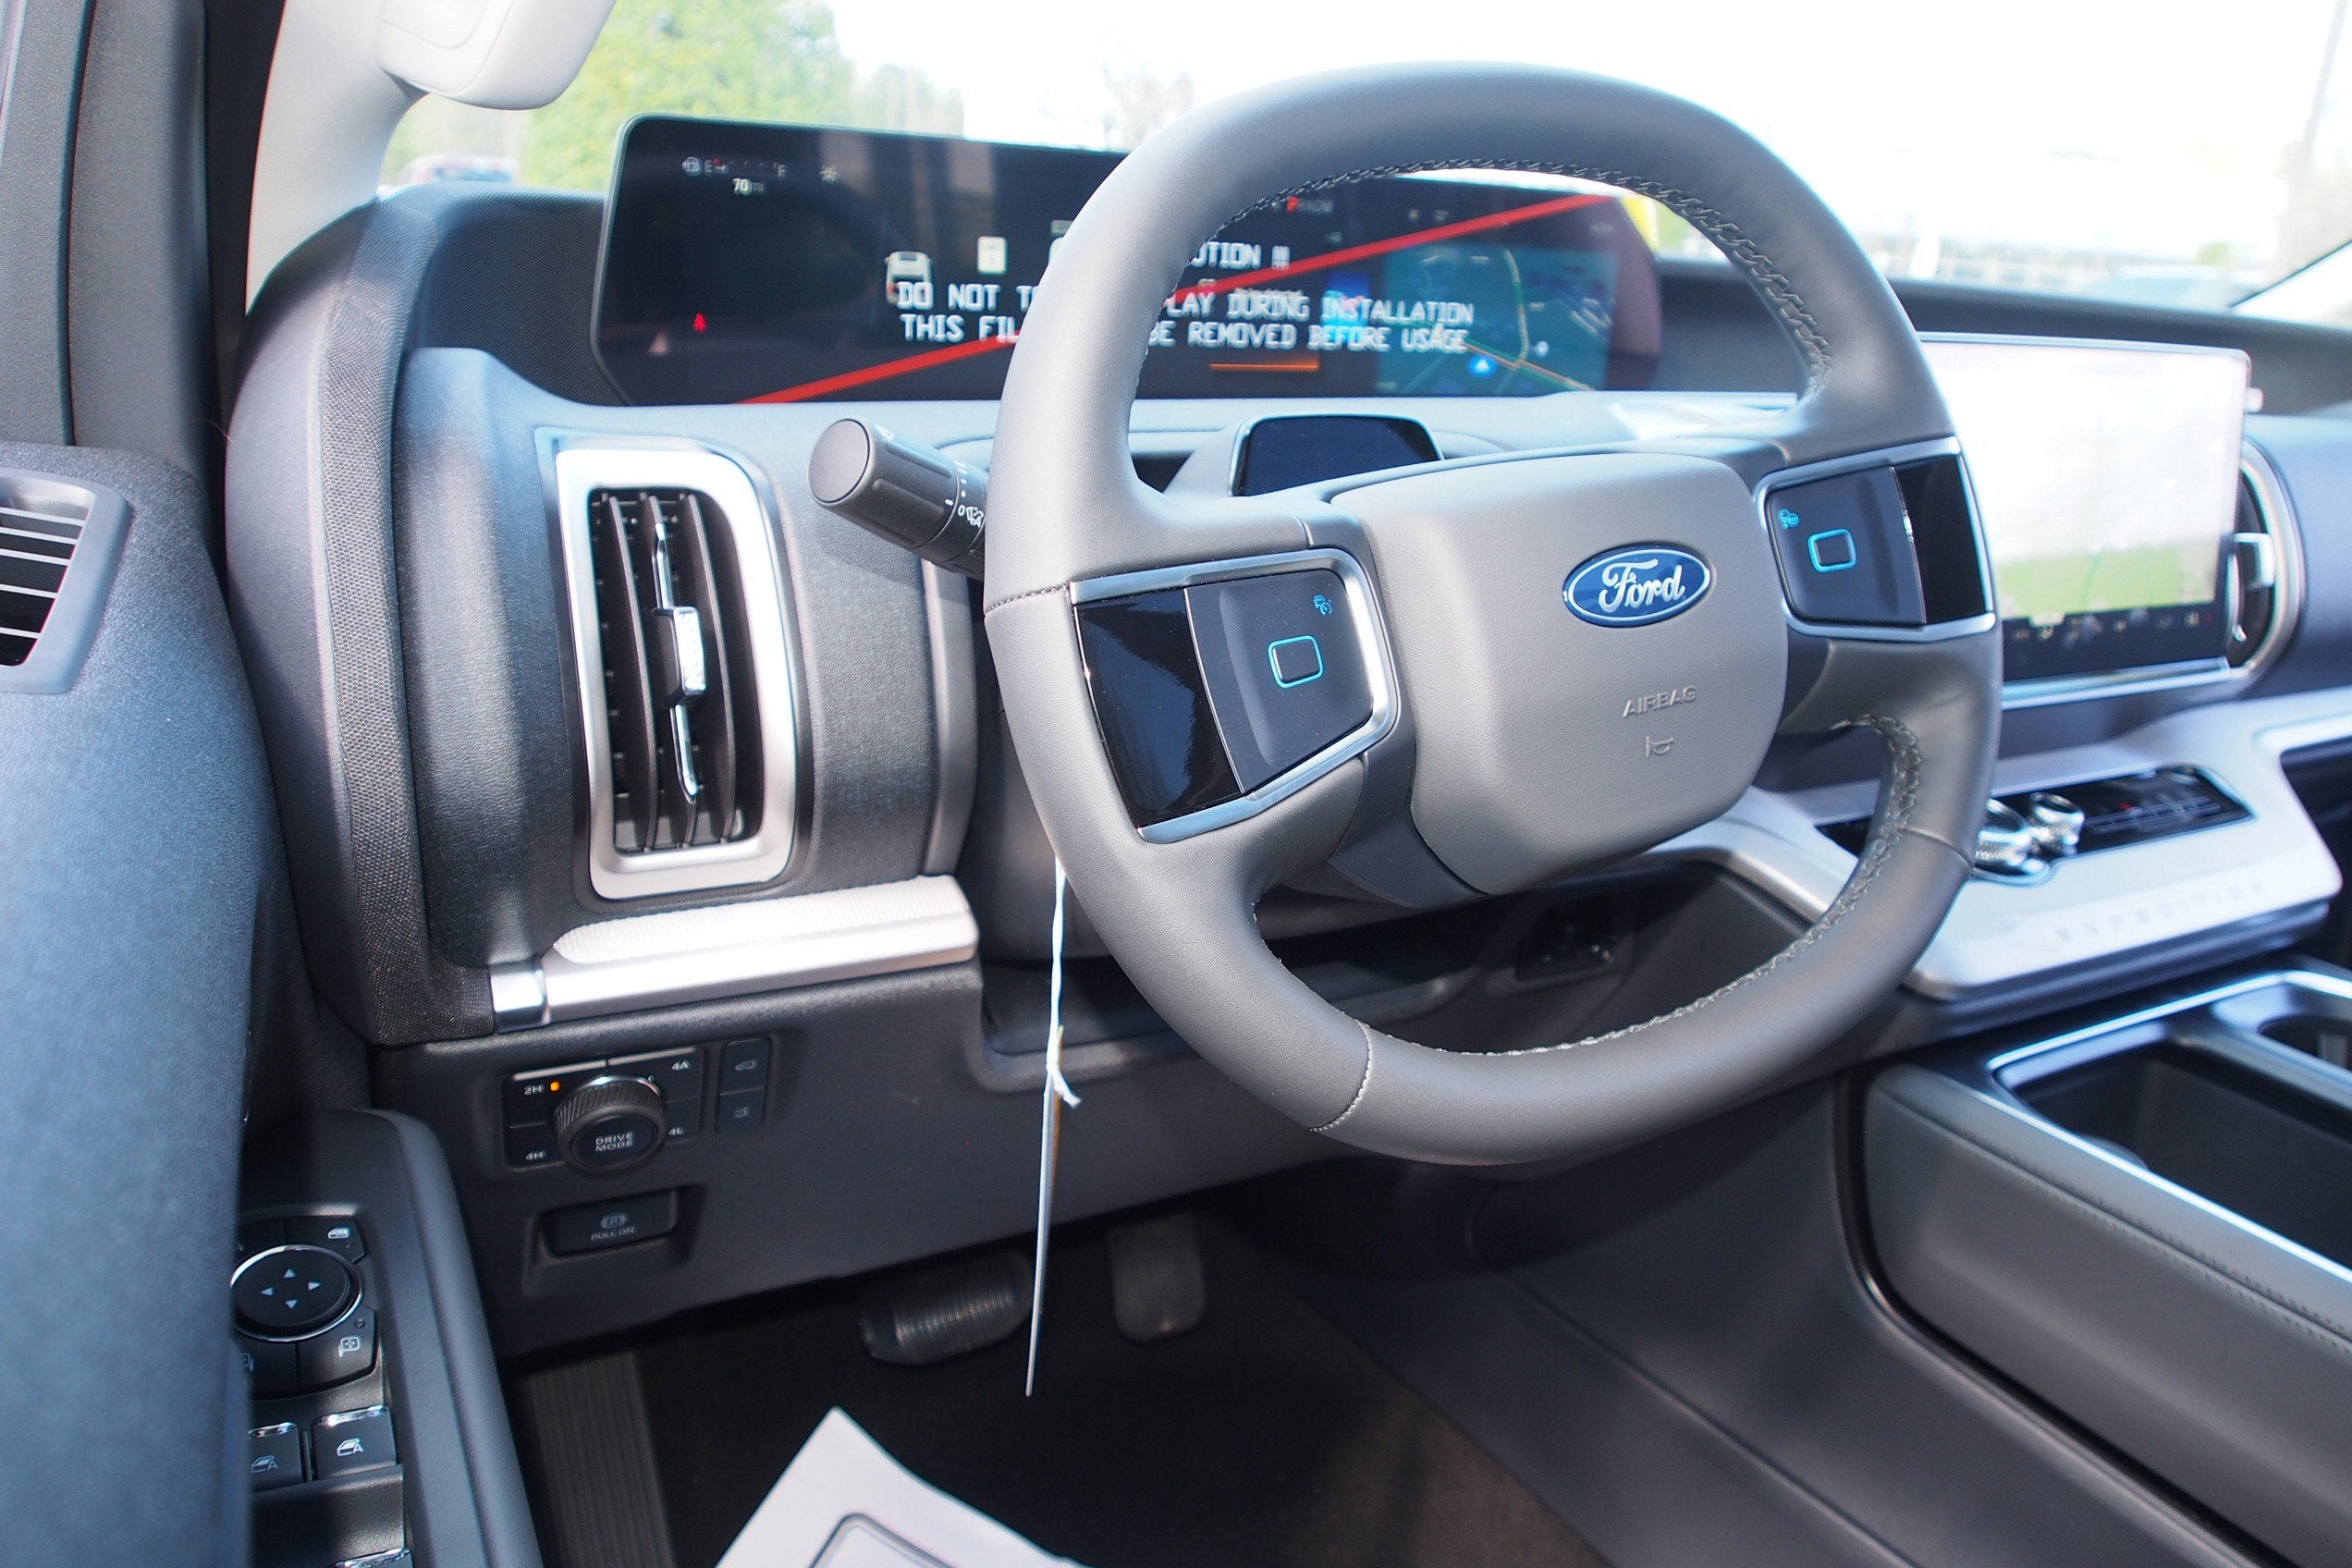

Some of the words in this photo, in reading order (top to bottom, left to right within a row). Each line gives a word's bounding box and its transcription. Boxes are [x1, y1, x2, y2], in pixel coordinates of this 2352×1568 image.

[732, 178, 753, 194] 70
[1190, 241, 1262, 269] UTION
[896, 281, 934, 311] DO
[948, 283, 1001, 312] NOT
[1226, 293, 1310, 322] DURING
[1321, 296, 1475, 325] INSTALLATION
[900, 313, 965, 343] THIS
[978, 315, 1021, 344] FIL
[1187, 321, 1297, 350] REMOVED
[1307, 325, 1390, 352] BEFORE
[1400, 324, 1469, 354] USAGE
[1599, 558, 1685, 613] Ford
[1623, 685, 1697, 718] AIRBAG
[671, 1060, 691, 1072] 4A
[523, 1084, 544, 1096] 2H
[595, 1131, 634, 1146] DRIVE
[595, 1139, 634, 1152] MODE
[525, 1150, 545, 1161] 4H
[619, 1226, 635, 1236] ON
